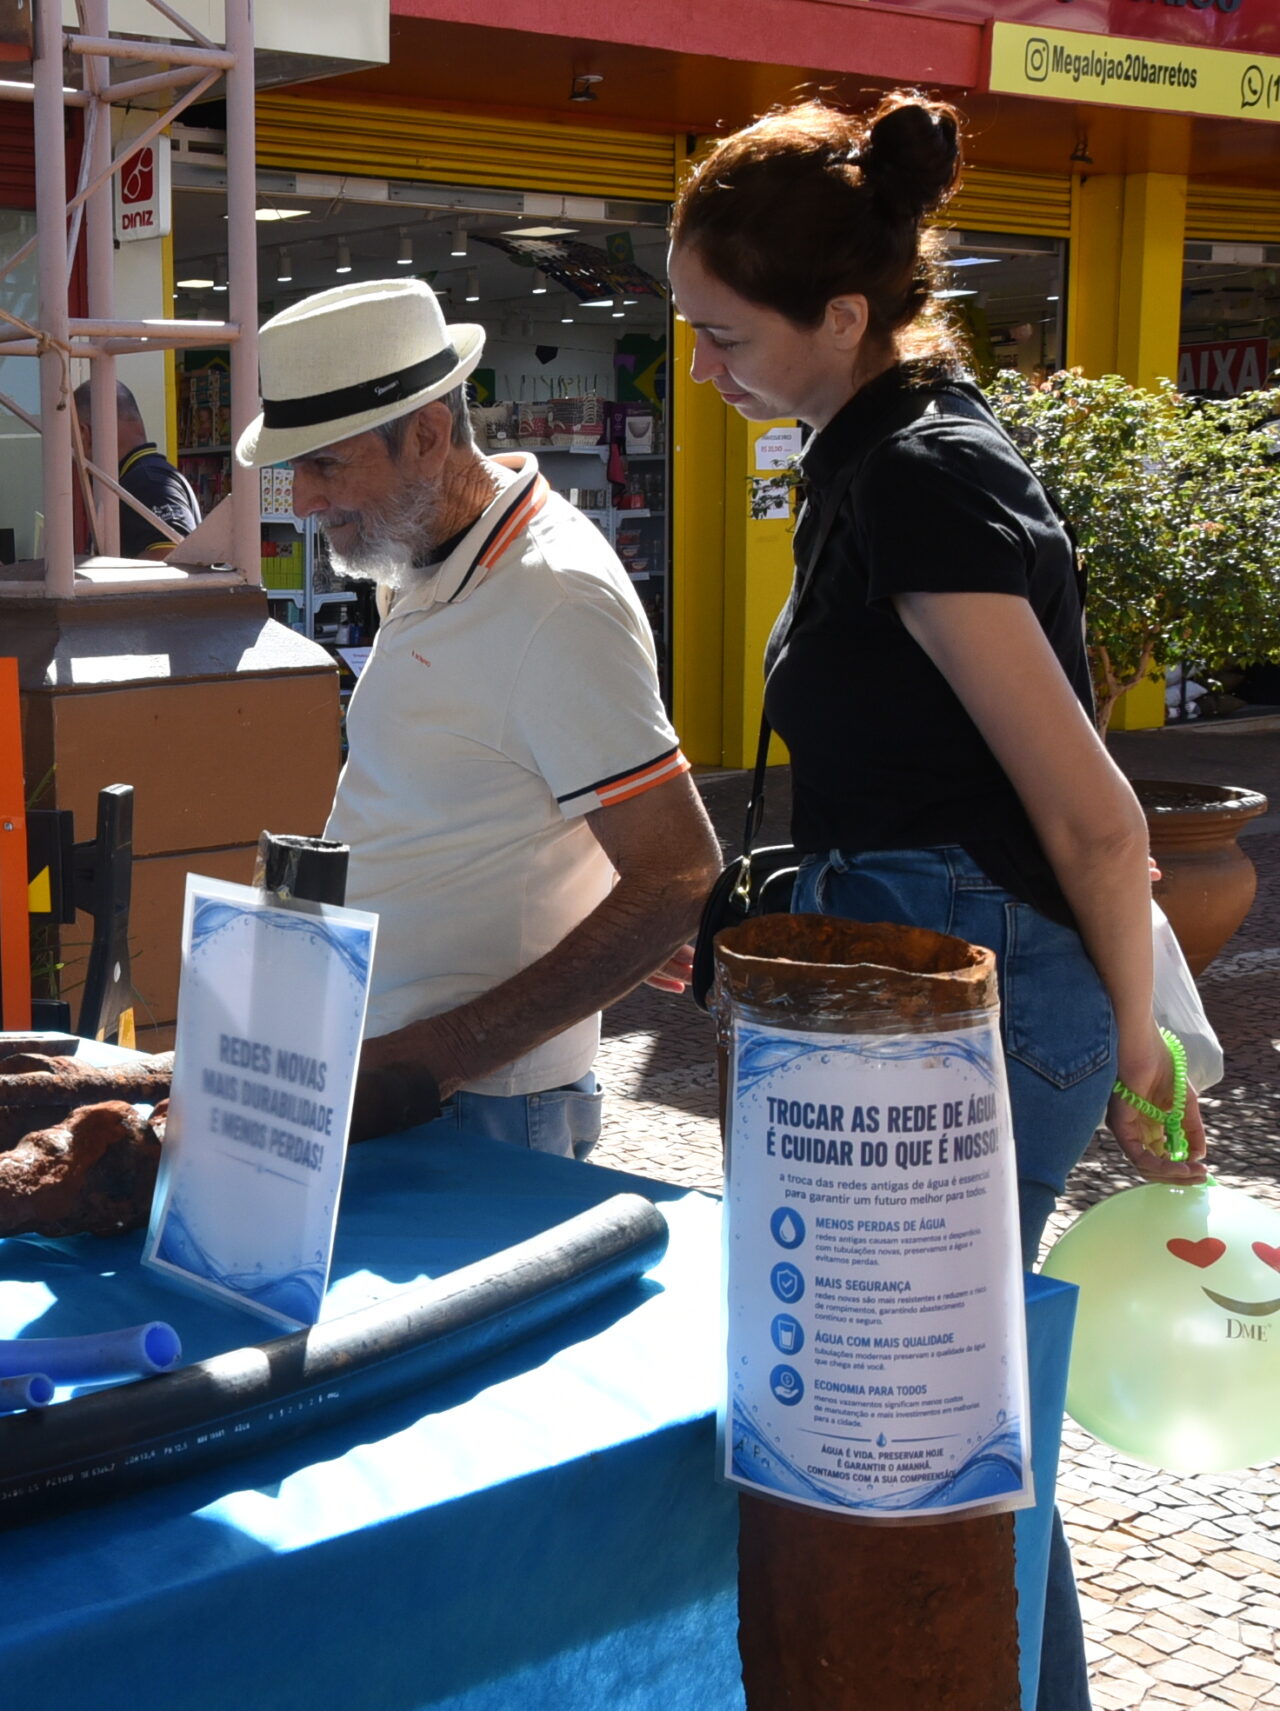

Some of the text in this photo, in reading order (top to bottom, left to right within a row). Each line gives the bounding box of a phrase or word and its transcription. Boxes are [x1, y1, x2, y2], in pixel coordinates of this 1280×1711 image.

[1051, 45, 1198, 88] Megalojao20barretos
[122, 210, 154, 230] DINIZ
[1178, 347, 1261, 392] AIXA
[219, 1033, 327, 1093] REDES NOVAS
[202, 1067, 333, 1136] MAIS DURABILIDADE
[766, 1093, 997, 1133] TROCAR AS REDE DE ÁGUA
[210, 1106, 324, 1173] E MENOS PERDAS!
[766, 1127, 999, 1171] É CUIDAR DO QUE É NOSSO!
[779, 1173, 785, 1182] a
[787, 1172, 813, 1187] troca
[815, 1177, 834, 1189] das
[837, 1179, 868, 1191] redes
[870, 1179, 909, 1194] antigas
[912, 1178, 924, 1191] de
[926, 1178, 949, 1192] água
[951, 1174, 957, 1187] é
[785, 1188, 807, 1201] para
[809, 1190, 850, 1206] garantir
[853, 1195, 871, 1205] um
[874, 1194, 907, 1206] futuro
[910, 1192, 943, 1206] melhor
[945, 1191, 964, 1205] para
[815, 1216, 946, 1233] MENOS PERDAS DE ÁGUA
[815, 1233, 836, 1243] redes
[838, 1235, 867, 1246] antigas
[869, 1236, 898, 1245] causam
[901, 1234, 941, 1244] vazamentos
[815, 1243, 832, 1252] com
[833, 1244, 875, 1257] tubulações
[878, 1247, 901, 1256] novas,
[904, 1245, 947, 1257] preservamos
[815, 1253, 880, 1268] evitamos perdas.
[815, 1276, 911, 1294] MAIS SEGURANÇA
[815, 1291, 835, 1301] redes
[837, 1294, 860, 1303] novas
[862, 1294, 876, 1304] são
[878, 1294, 895, 1304] mais
[897, 1294, 935, 1304] resistentes
[815, 1301, 824, 1310] de
[879, 1305, 917, 1316] garantindo
[919, 1301, 965, 1313] abastecimento
[856, 1317, 883, 1326] seguro.
[815, 1330, 955, 1349] ÁGUA COM MAIS QUALIDADE
[814, 1347, 854, 1359] tubulações
[855, 1351, 892, 1361] modernas
[893, 1351, 929, 1361] preservam
[814, 1357, 827, 1366] que
[829, 1359, 851, 1369] chega
[852, 1360, 865, 1370] até
[814, 1379, 927, 1396] ECONOMIA PARA TODOS
[814, 1395, 837, 1404] menos
[839, 1399, 882, 1409] vazamentos
[884, 1399, 920, 1410] significam
[921, 1398, 942, 1406] menos
[813, 1414, 829, 1424] para
[814, 1404, 823, 1412] de
[824, 1406, 869, 1419] manutenção
[877, 1411, 894, 1419] mais
[896, 1408, 941, 1418] investimentos
[821, 1444, 944, 1460] ÁGUA É VIDA. PRESERVAR HOJE
[837, 1458, 842, 1468] É
[844, 1461, 887, 1471] GARANTIR
[888, 1462, 894, 1471] O
[807, 1464, 850, 1480] CONTAMOS
[852, 1472, 871, 1483] COM
[873, 1473, 879, 1483] A
[882, 1473, 898, 1484] SUA
